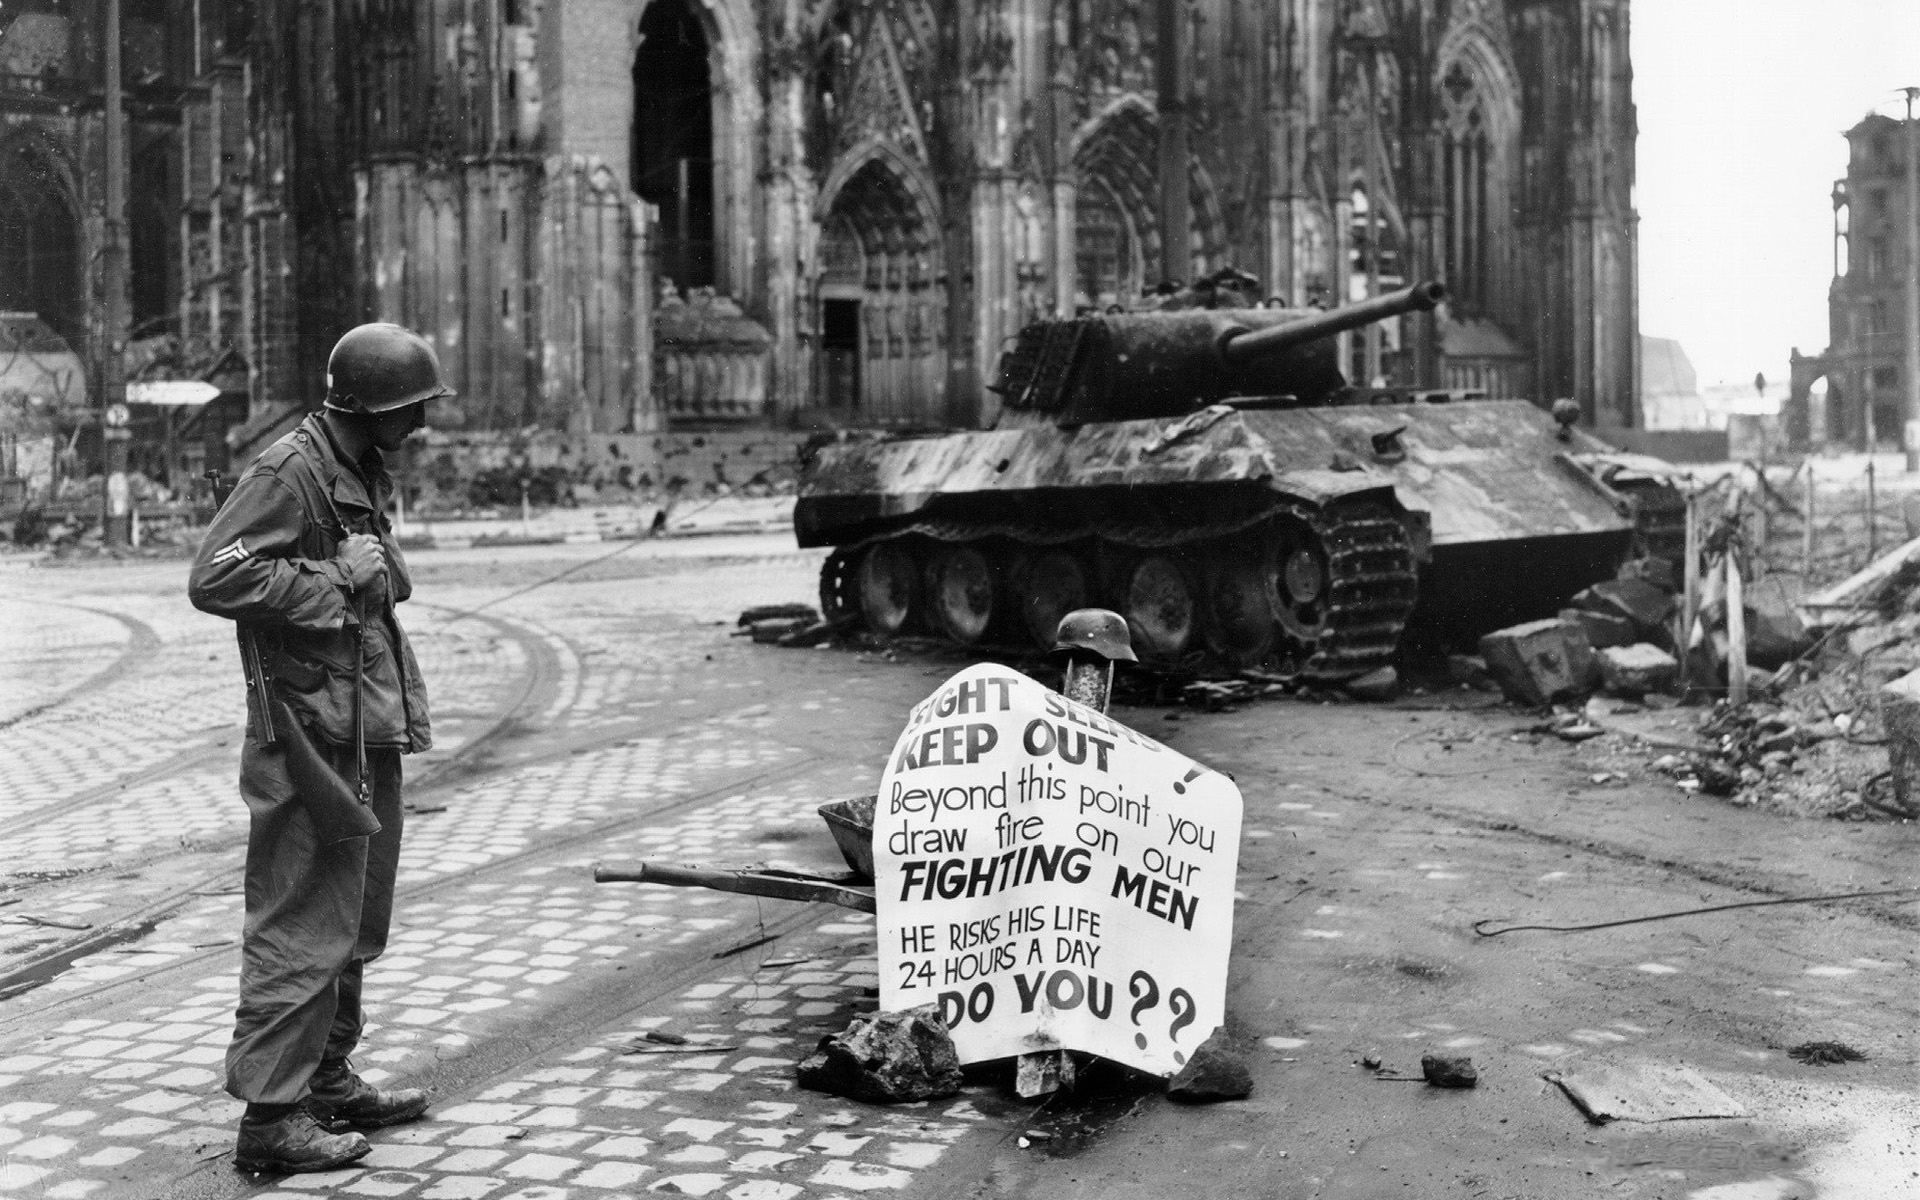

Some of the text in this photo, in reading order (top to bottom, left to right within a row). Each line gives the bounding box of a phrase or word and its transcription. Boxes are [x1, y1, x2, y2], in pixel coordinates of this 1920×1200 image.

[894, 723, 999, 775] KEEP
[890, 762, 1216, 853] Beyond this point you
[889, 812, 1201, 887] draw fire on our
[900, 844, 1200, 931] FIGHTING MEN
[901, 905, 1101, 954] HE RISKS HIS LIFE
[899, 937, 1102, 990] 24 HOURS A DAY
[937, 981, 995, 1031] DO
